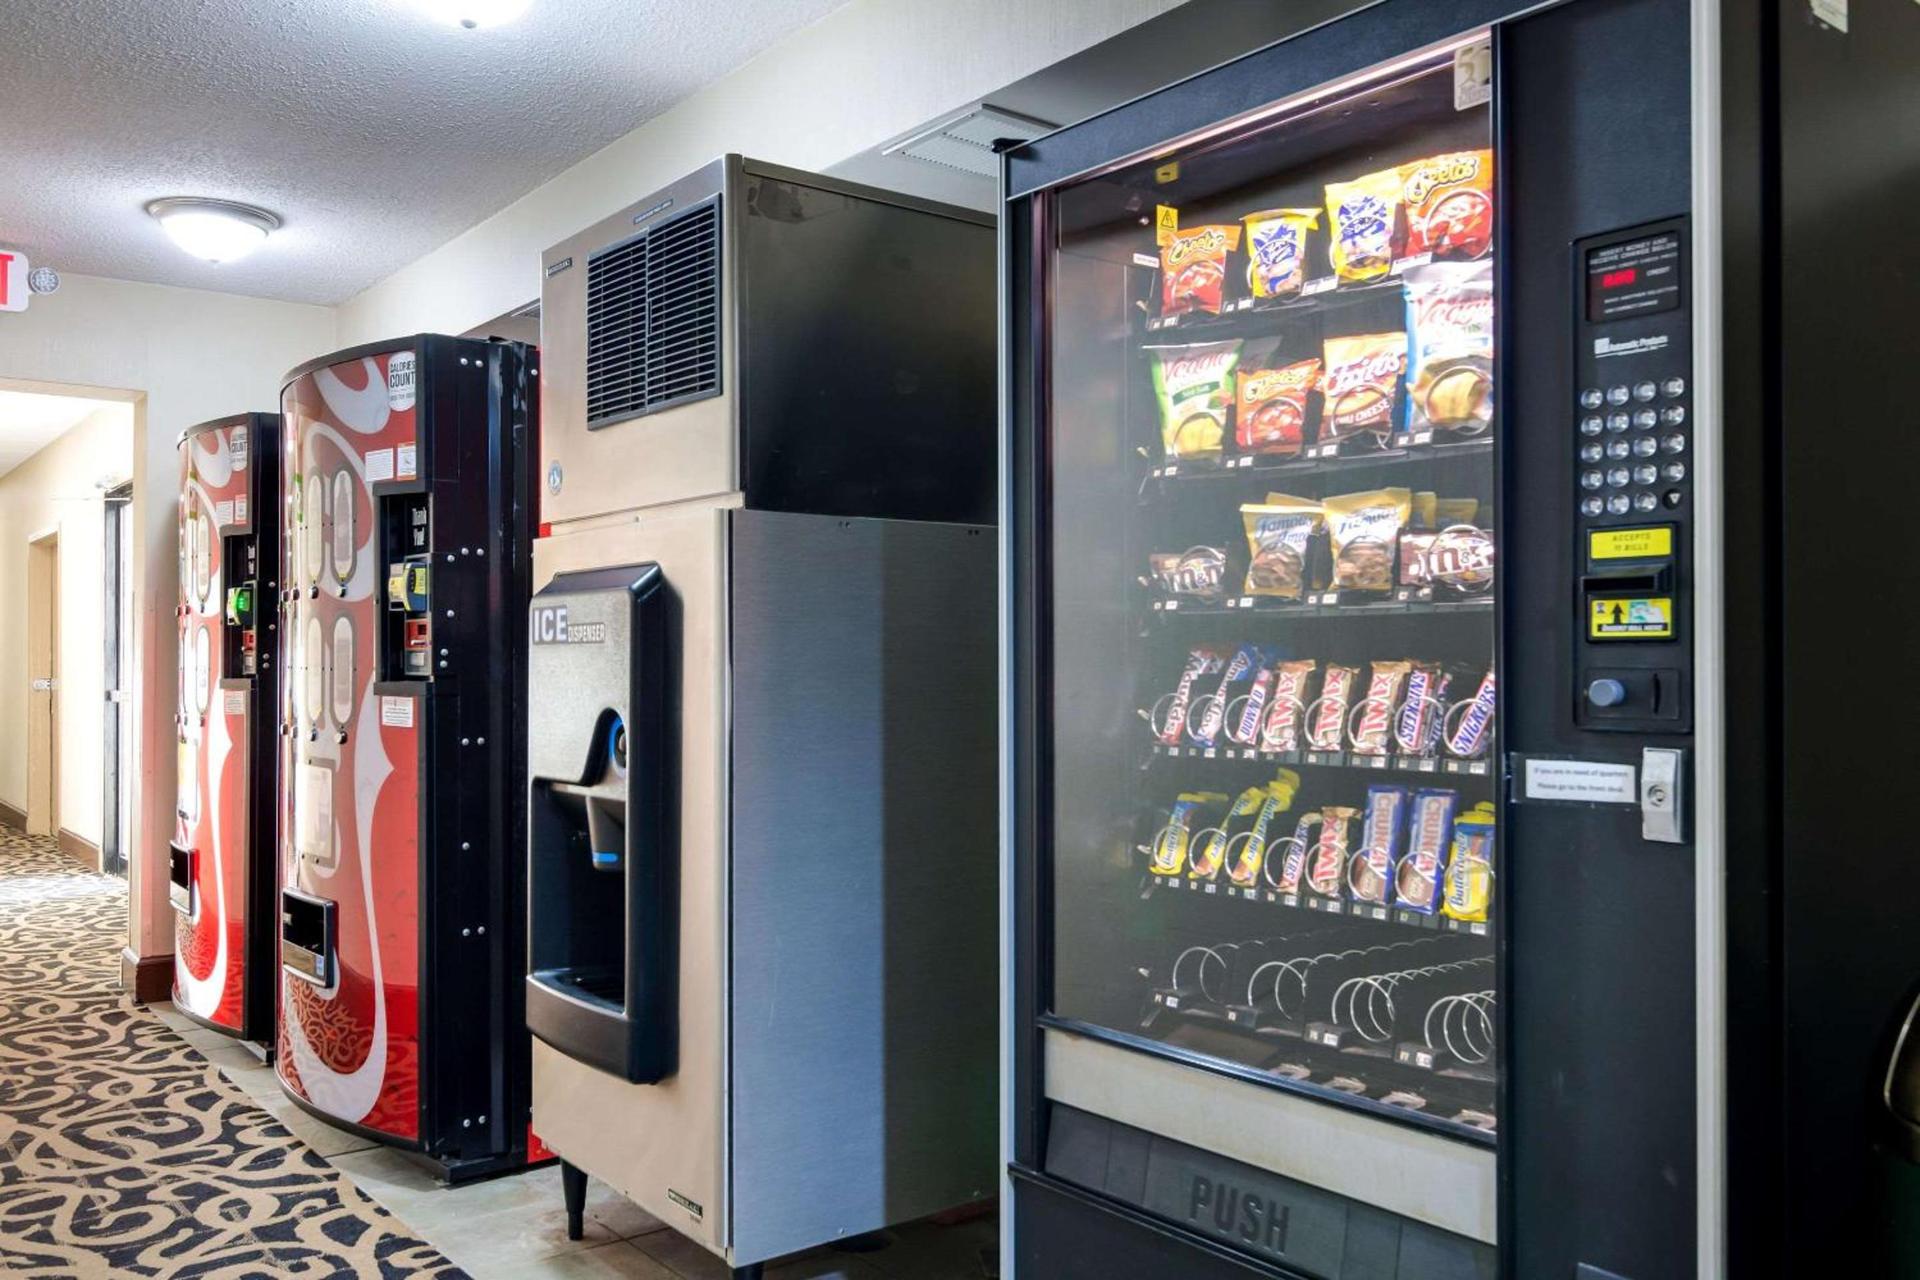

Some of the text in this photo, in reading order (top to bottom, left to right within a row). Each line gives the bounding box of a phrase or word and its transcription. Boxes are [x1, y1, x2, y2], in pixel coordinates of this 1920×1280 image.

[390, 371, 416, 388] COUNT
[533, 608, 568, 642] ICE
[1265, 672, 1298, 742] TWIX
[1314, 669, 1343, 742] TWIX
[1358, 673, 1393, 741] TWIX
[1314, 817, 1341, 881] TWIX
[1190, 1176, 1289, 1255] PUSH
